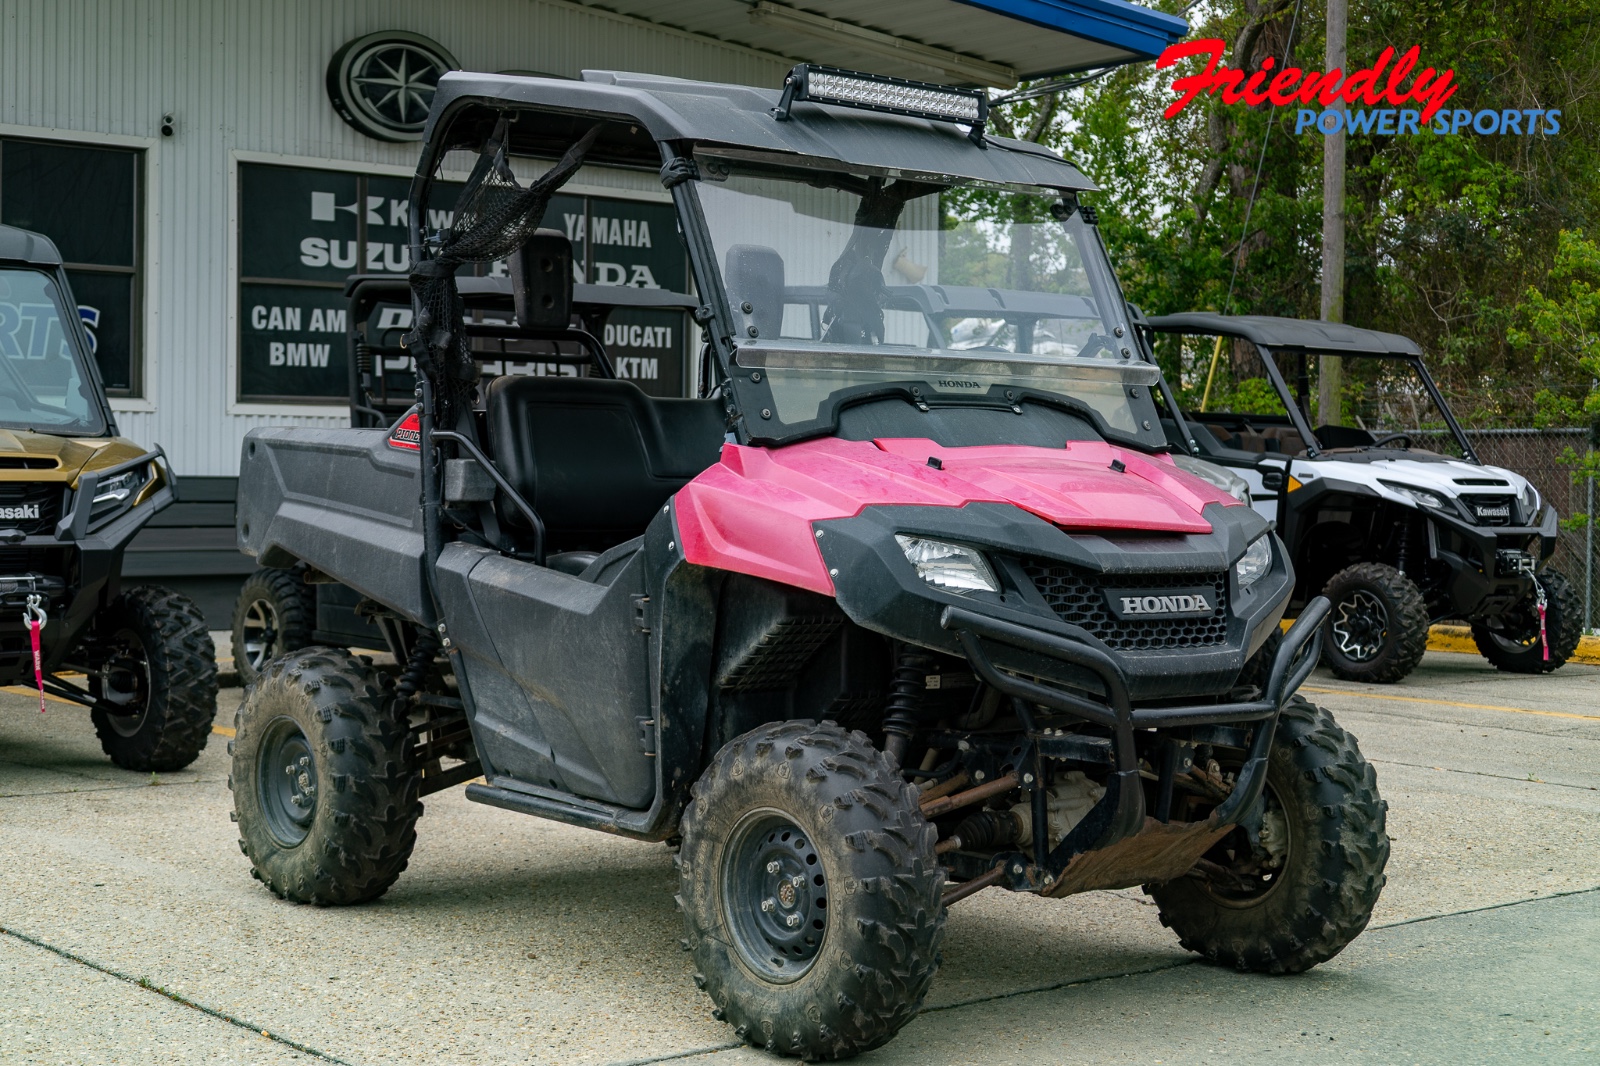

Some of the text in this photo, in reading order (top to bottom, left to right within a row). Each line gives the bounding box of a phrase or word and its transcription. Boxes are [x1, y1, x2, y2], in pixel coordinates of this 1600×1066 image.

[563, 213, 652, 248] YAMAHA
[300, 236, 443, 273] SUZU
[251, 304, 302, 331] CAN
[308, 308, 347, 333] AM
[604, 323, 672, 348] DUCATI
[269, 341, 331, 368] BMW
[616, 356, 658, 379] KTM
[938, 380, 981, 389] HONDA
[1476, 506, 1510, 516] Kawasaki
[1120, 594, 1212, 614] HONDA
